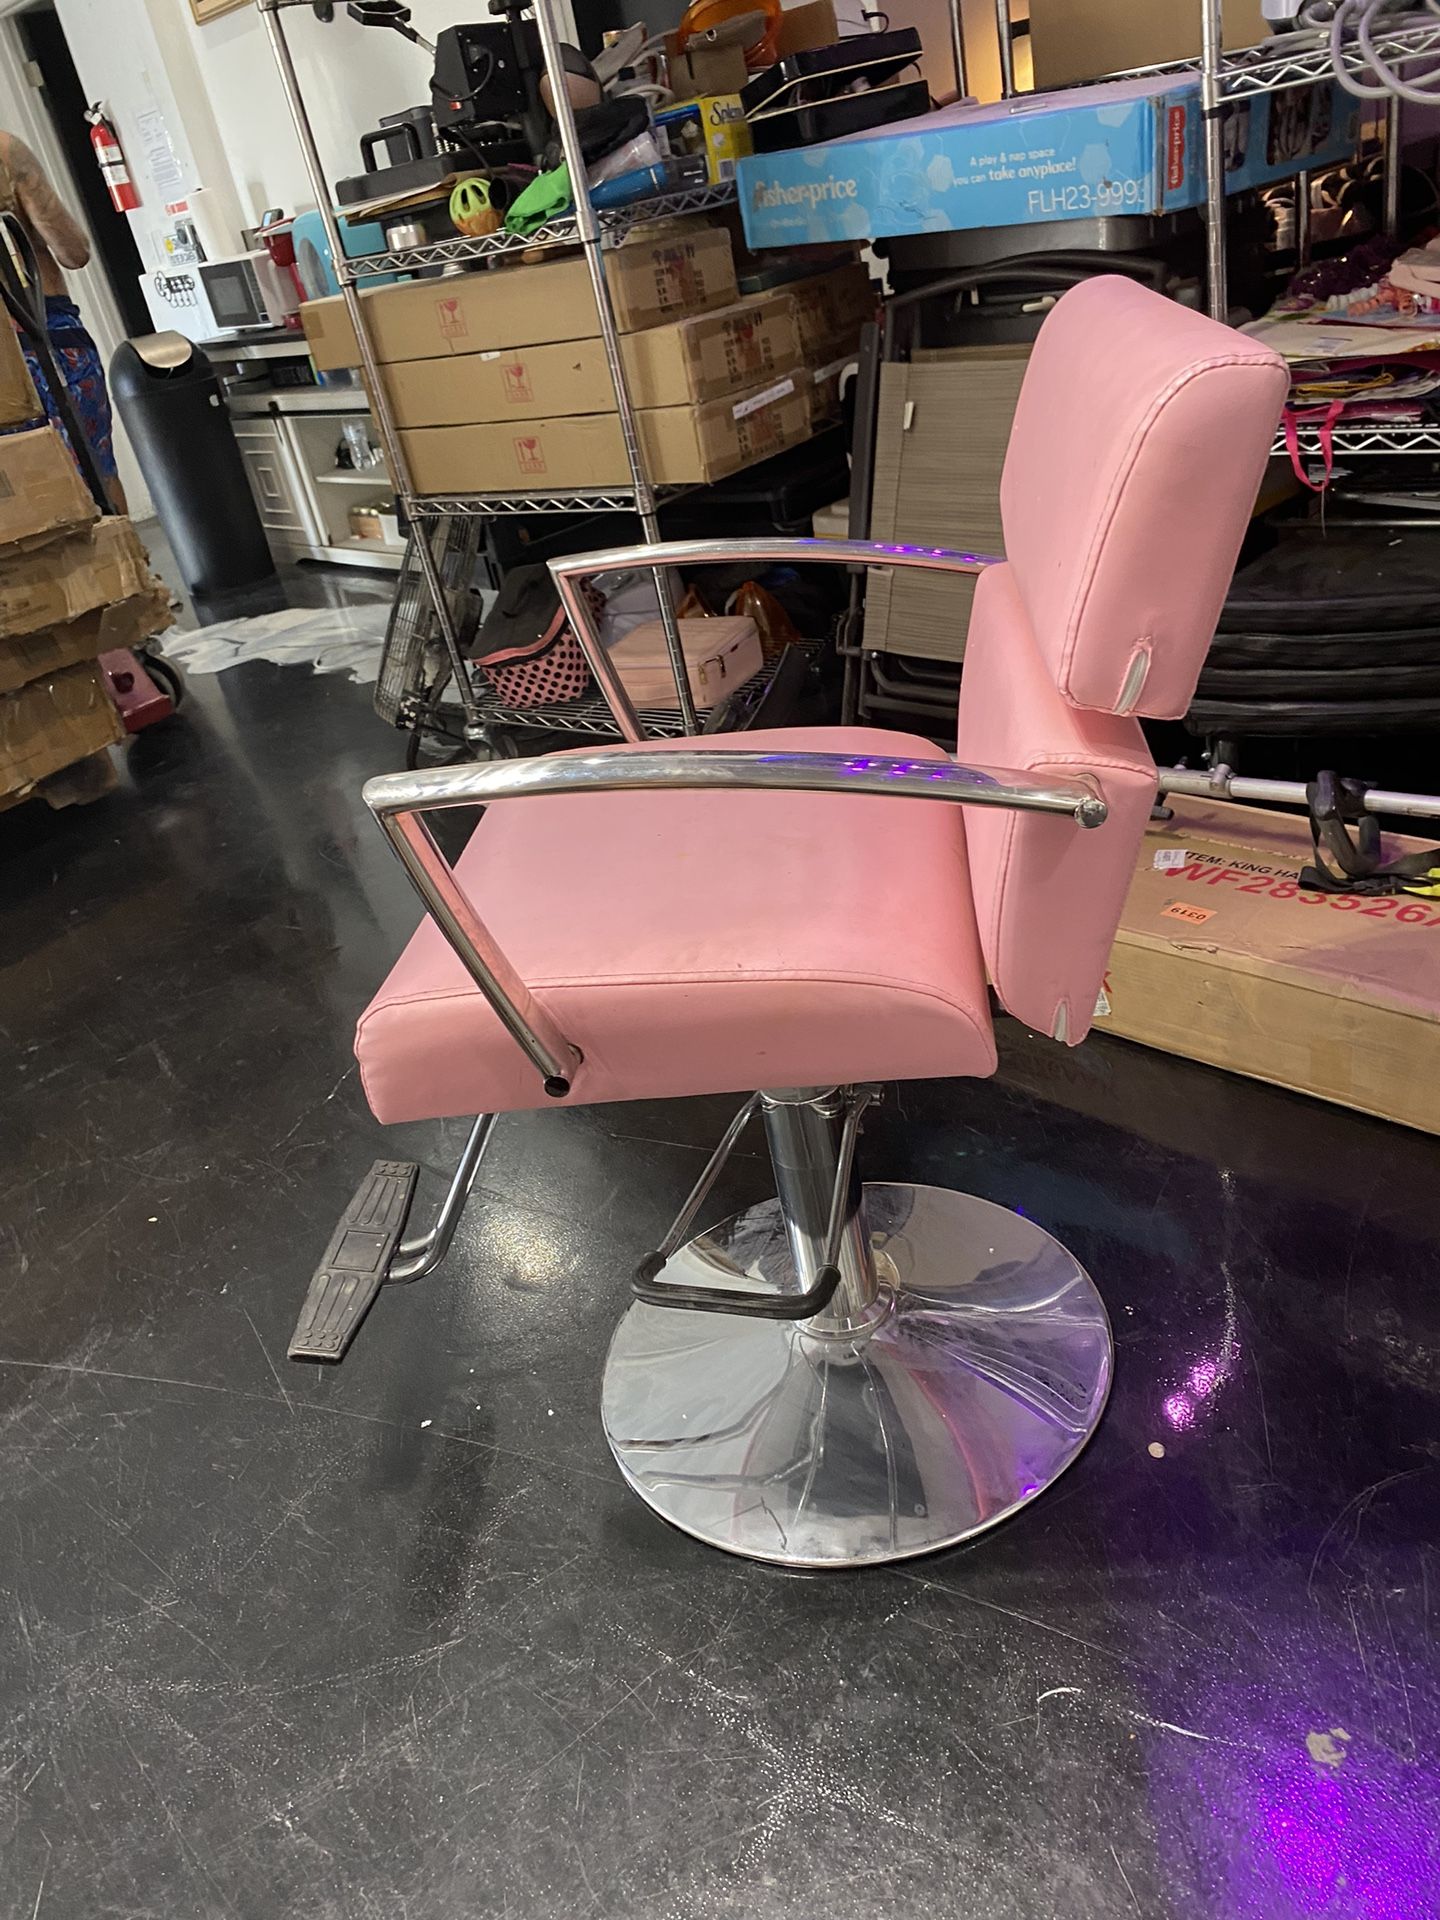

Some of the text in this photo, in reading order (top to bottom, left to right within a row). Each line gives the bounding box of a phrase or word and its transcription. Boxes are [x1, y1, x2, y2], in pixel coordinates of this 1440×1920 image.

[969, 156, 977, 167] A
[979, 154, 998, 168] play
[1028, 148, 1056, 160] space
[970, 174, 986, 184] can
[988, 165, 1016, 181] take
[1018, 157, 1076, 179] anyplace!
[1185, 851, 1226, 865] TEM:
[1228, 860, 1272, 875] KING
[1170, 907, 1206, 921] 0319
